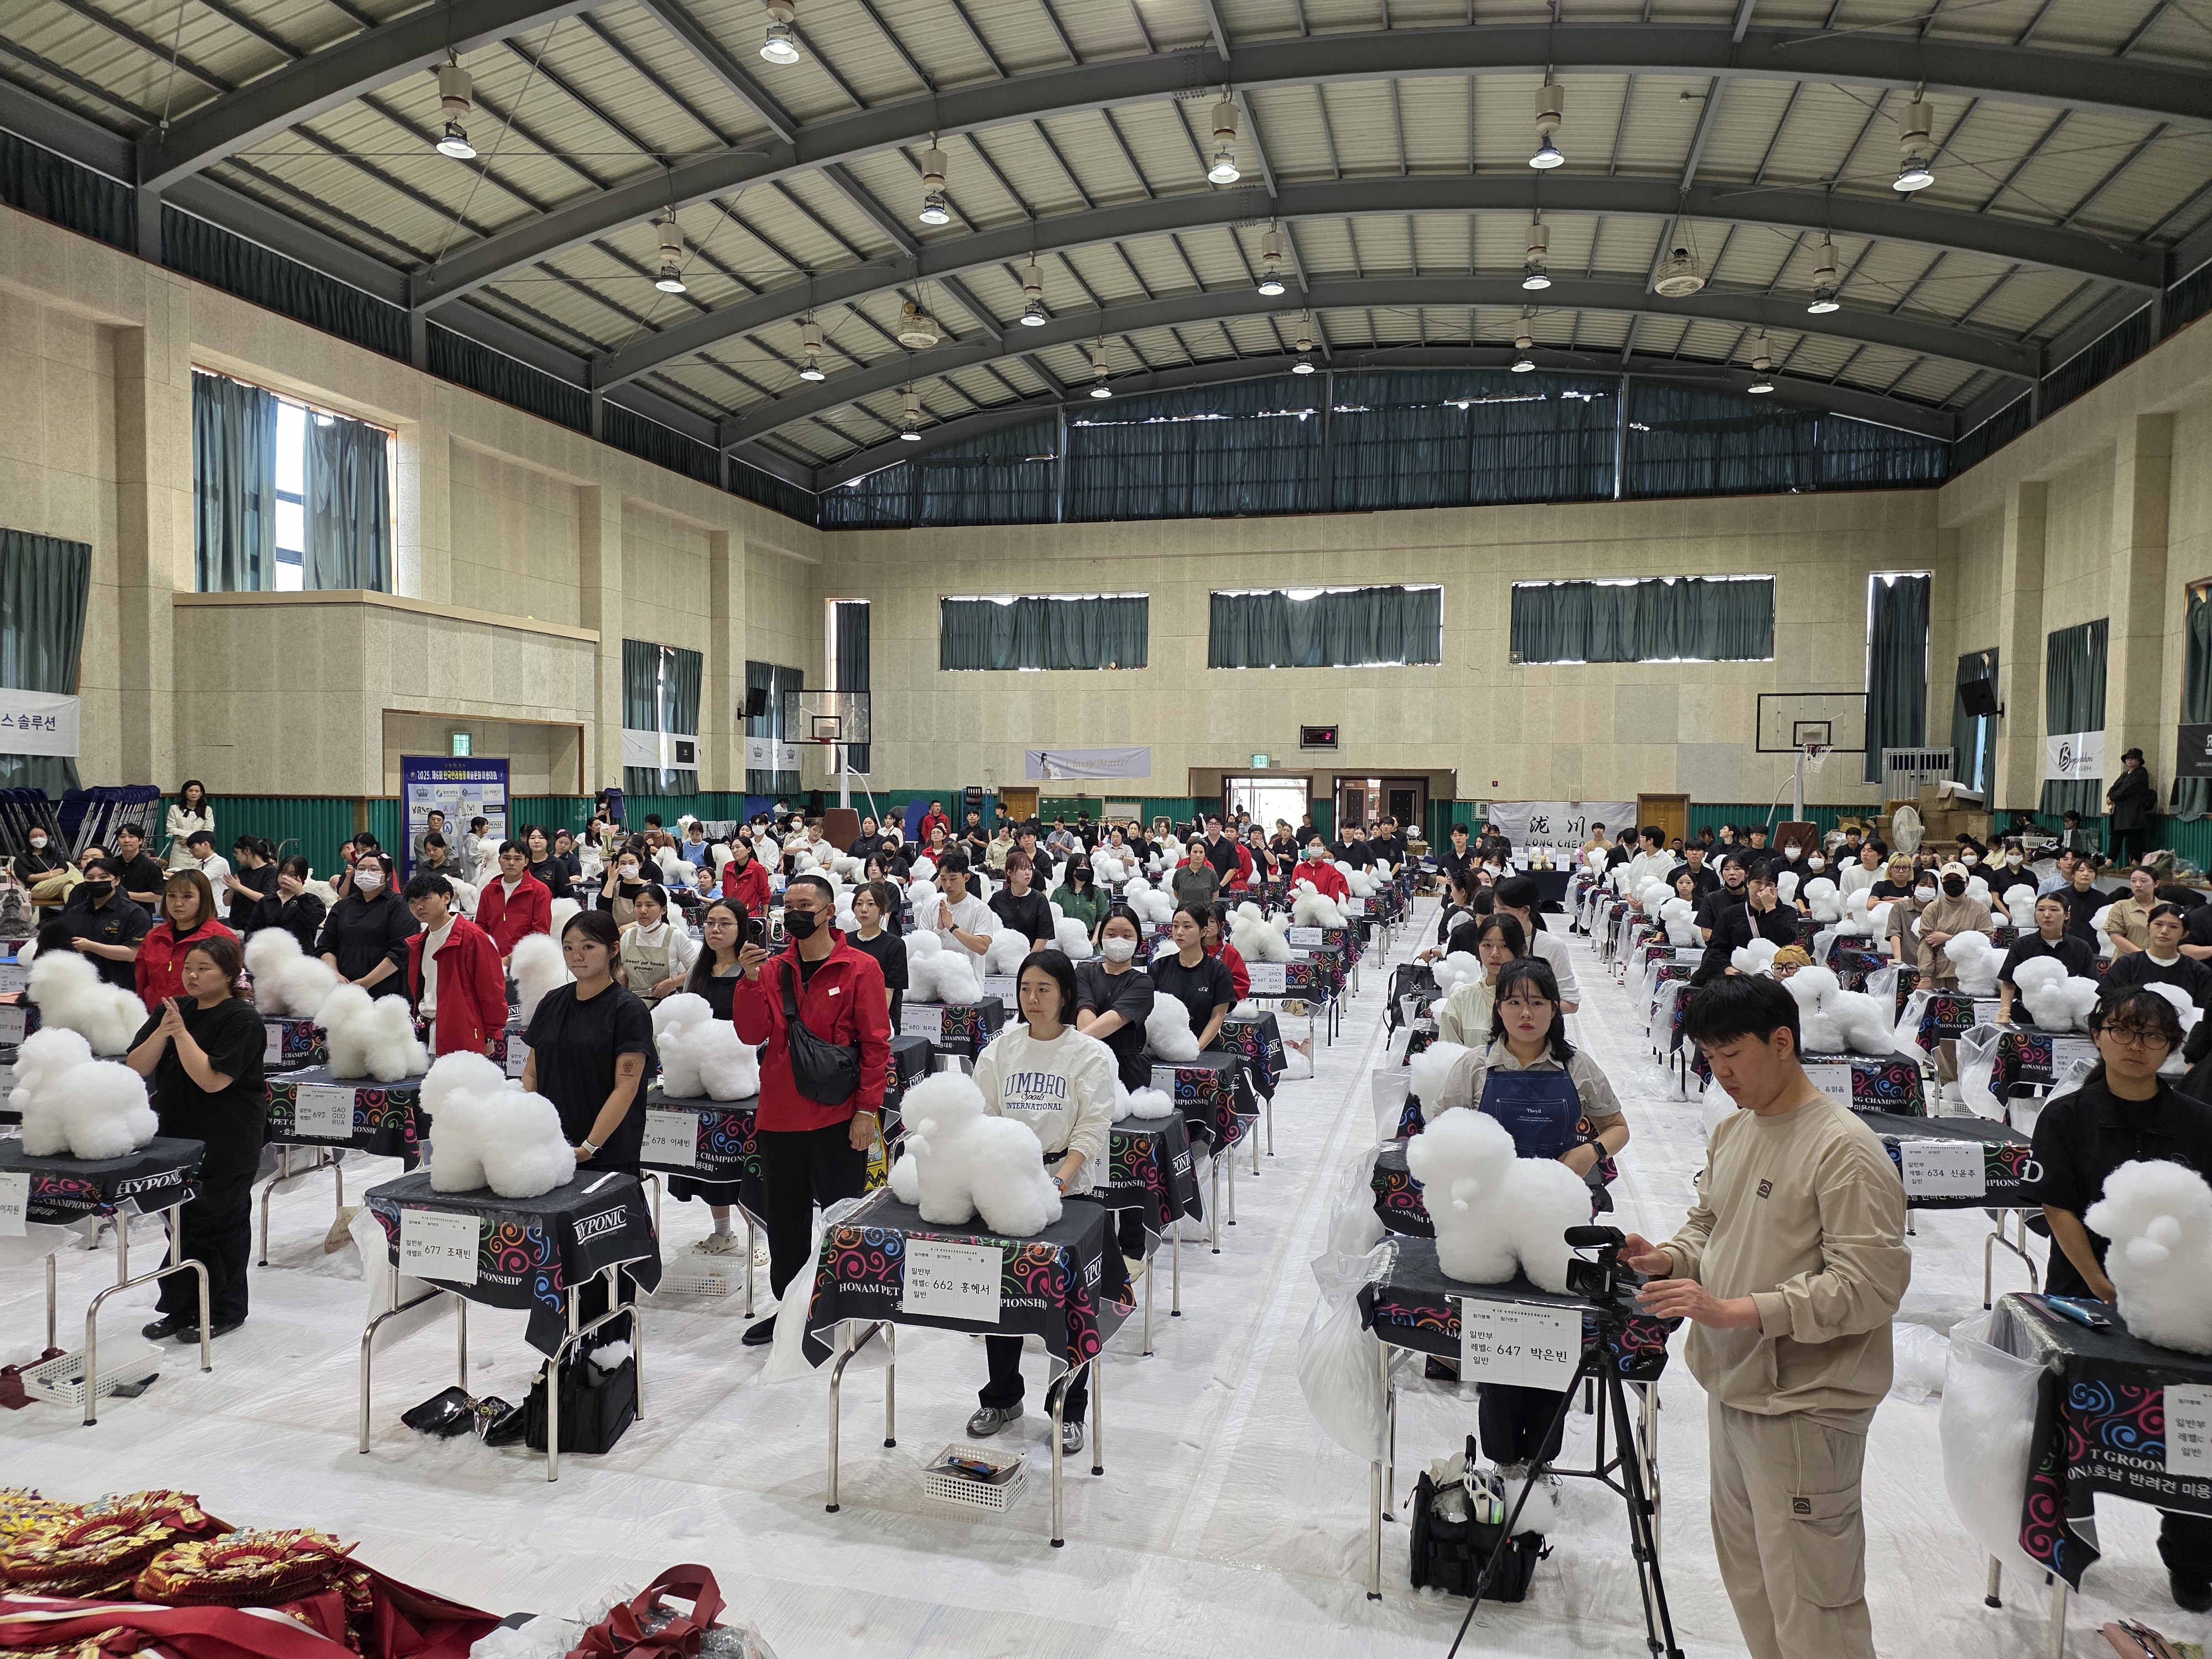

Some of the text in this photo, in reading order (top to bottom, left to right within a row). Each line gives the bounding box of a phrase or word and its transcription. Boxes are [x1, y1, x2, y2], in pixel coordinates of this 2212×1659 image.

[18, 714, 55, 731] 솔루션
[1066, 758, 1130, 770] Classy Master
[417, 770, 431, 780] 2025.
[1525, 838, 1585, 848] LONG CHEO
[1004, 1072, 1066, 1099] UMBRO
[1021, 1091, 1045, 1102] Sports
[1006, 1102, 1063, 1110] INTERNATIONAL
[671, 1139, 690, 1147] 이세빈
[701, 1152, 745, 1163] CHAMPIONS
[696, 1161, 713, 1172] 용대회
[1950, 1170, 1976, 1178] 신윤주
[1110, 1180, 1145, 1188] PIONSHI
[573, 1208, 627, 1241] HYPONIC
[425, 1245, 471, 1259] 677 조재빈
[911, 1267, 931, 1276] 일반부
[478, 1270, 522, 1285] PIONSHIP
[839, 1282, 900, 1296] HONAM PET
[933, 1280, 953, 1290] 662
[1000, 1298, 1047, 1311] PIONSHIP
[1469, 1330, 1494, 1340] 일반부
[1497, 1344, 1567, 1363] 647 박은빈
[1473, 1356, 1489, 1365] 일반
[2174, 1417, 2206, 1429] 일반부
[2180, 1447, 2202, 1458] 일반
[2092, 1464, 2212, 1499] 호남 반려견 미용
